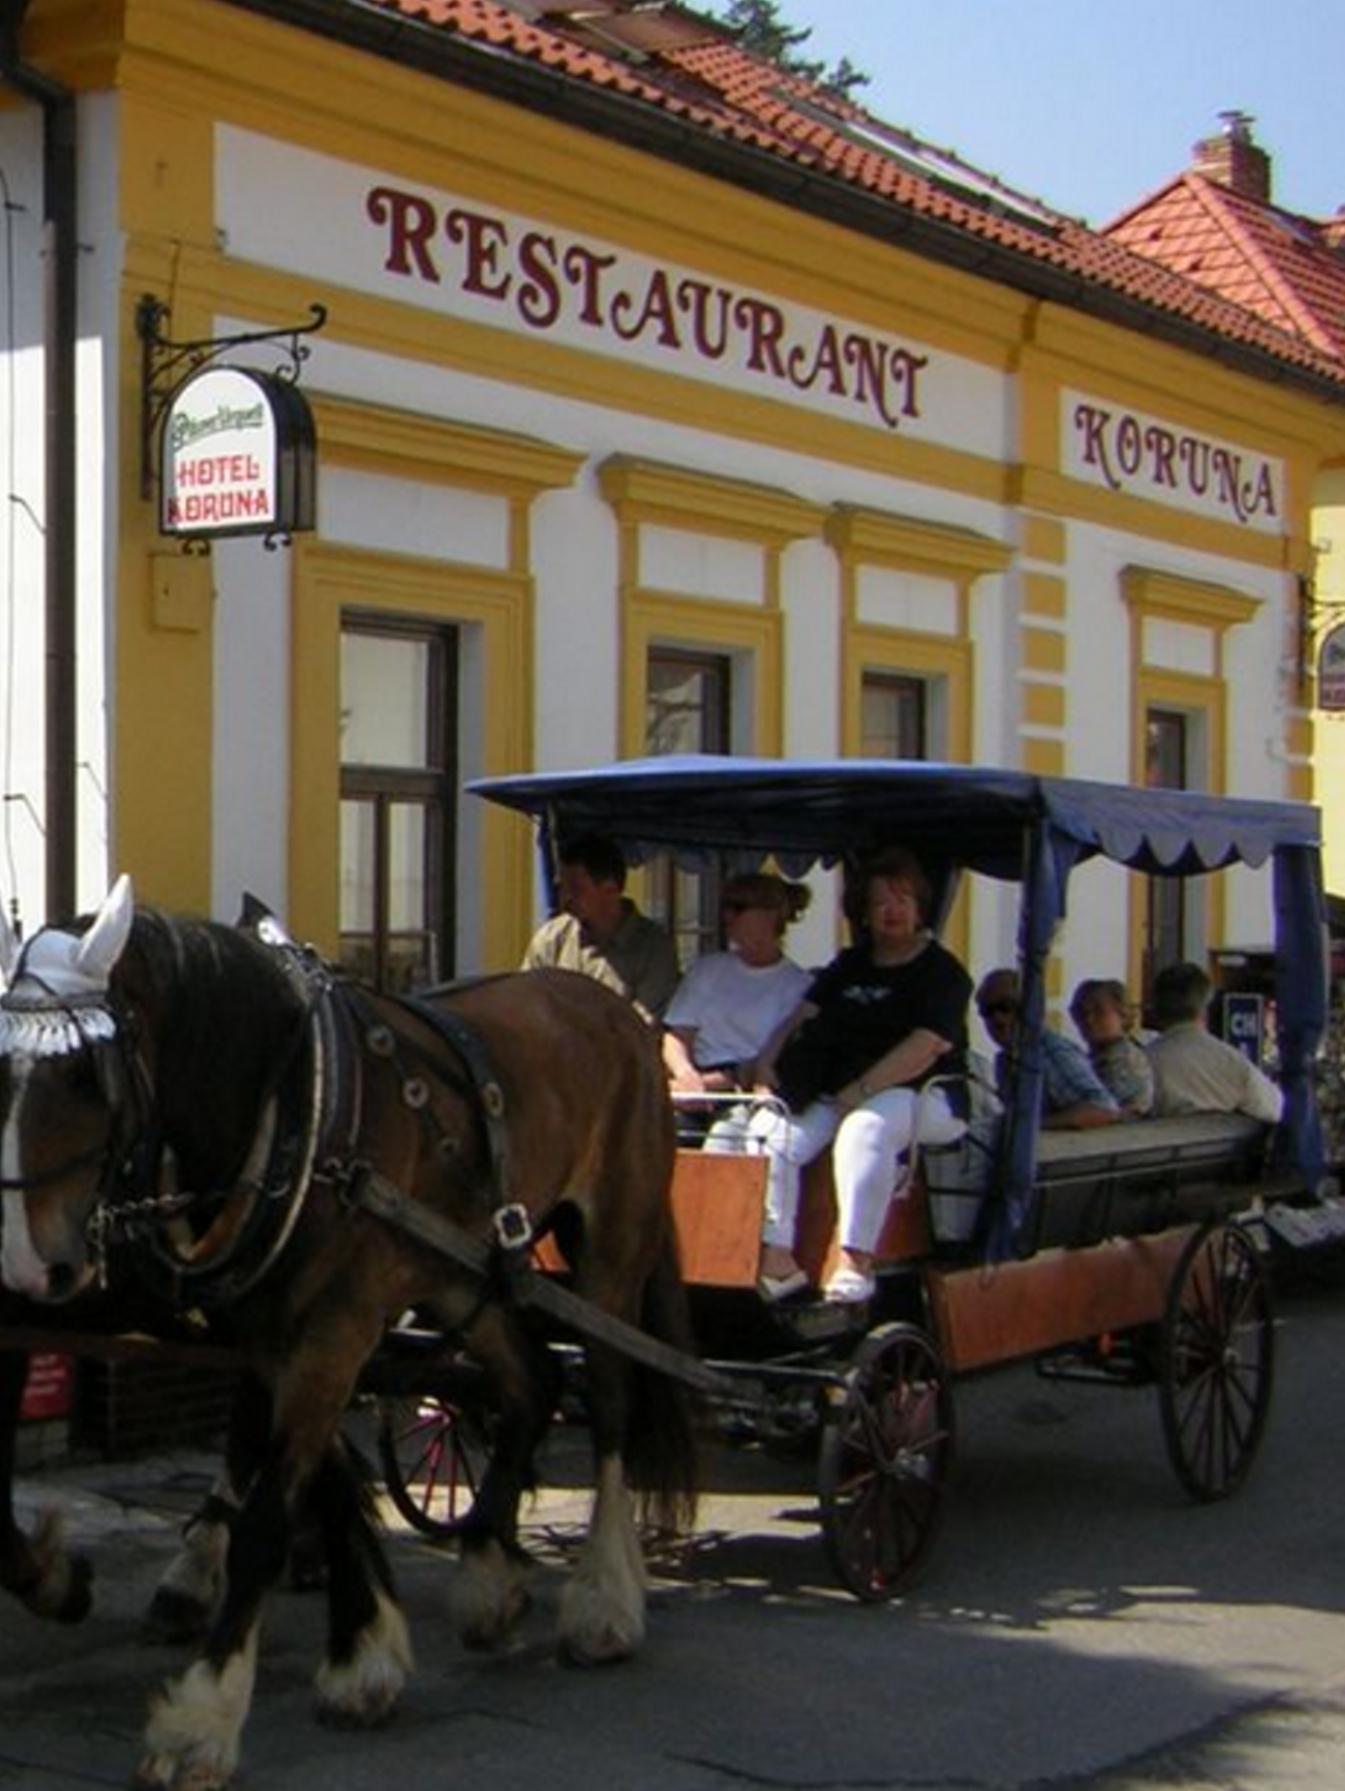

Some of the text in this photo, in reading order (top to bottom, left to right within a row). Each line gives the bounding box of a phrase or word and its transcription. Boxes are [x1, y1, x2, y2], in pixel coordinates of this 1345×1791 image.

[367, 187, 928, 428] RESTAURANT
[178, 454, 259, 487] HOTEL
[1074, 404, 1277, 523] KORUNA
[167, 488, 269, 523] KORUNA
